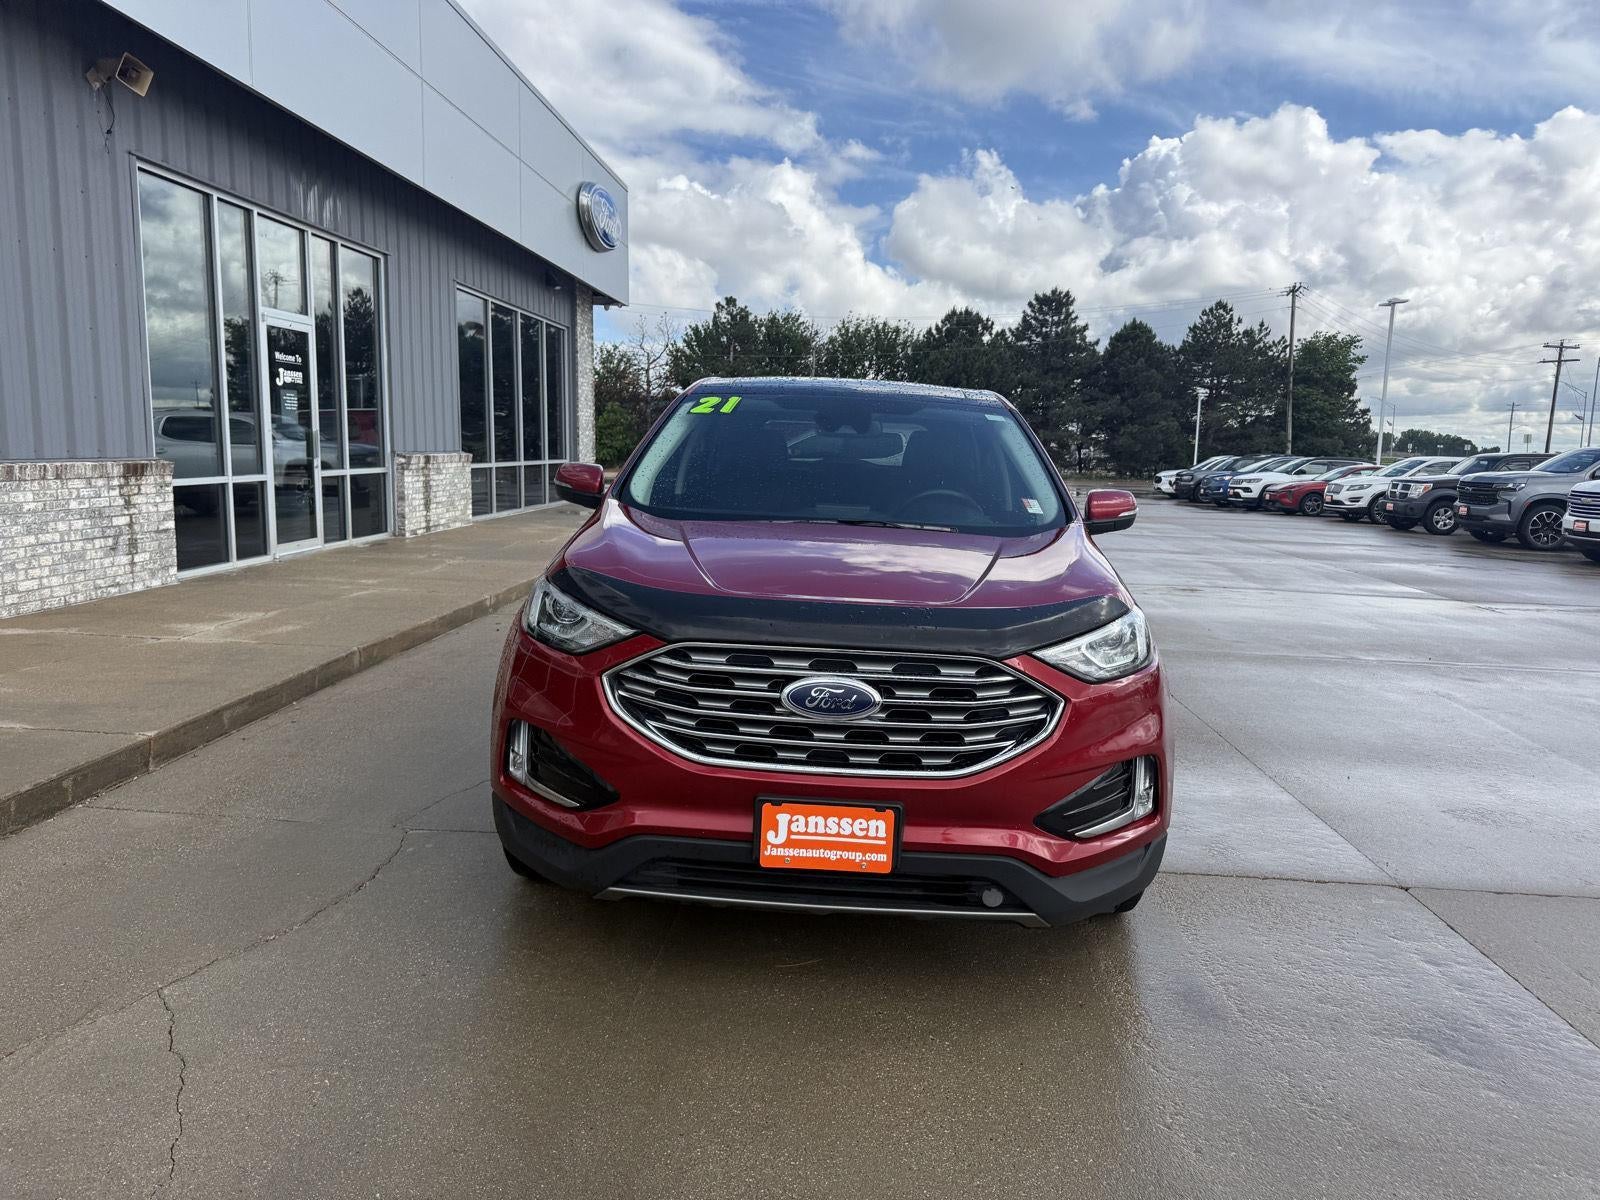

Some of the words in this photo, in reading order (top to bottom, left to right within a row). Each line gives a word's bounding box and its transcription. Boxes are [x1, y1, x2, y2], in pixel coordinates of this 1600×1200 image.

[275, 351, 295, 362] Welcome
[295, 354, 302, 363] To
[276, 367, 303, 386] Janssen
[690, 396, 742, 413] 21
[805, 686, 857, 710] Ford
[766, 813, 886, 845] Janssen
[764, 844, 887, 863] Janssenautogroup.com
